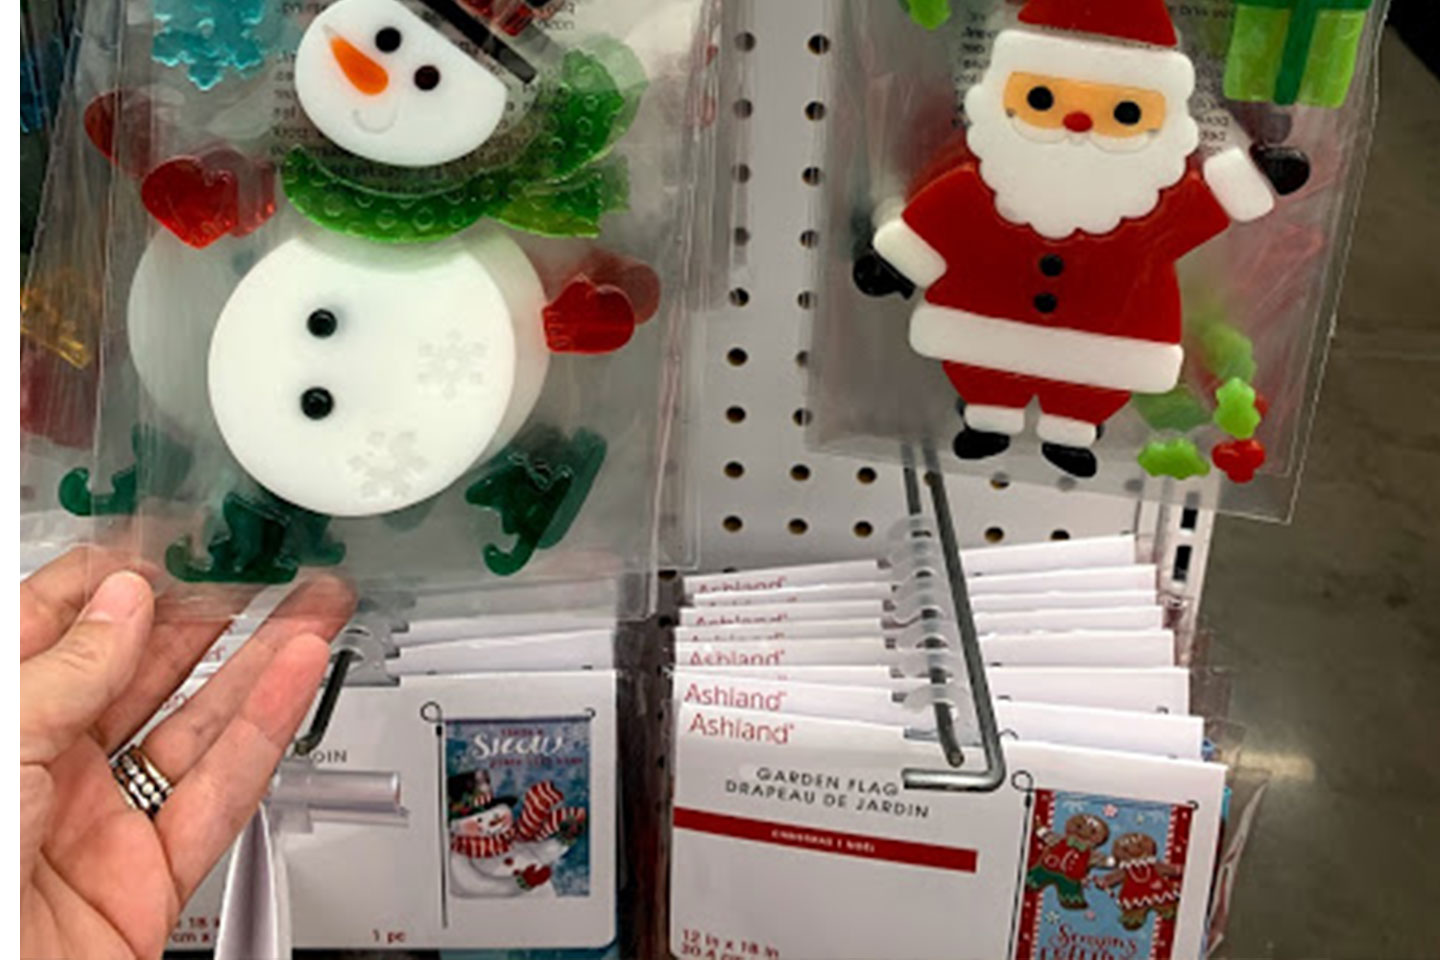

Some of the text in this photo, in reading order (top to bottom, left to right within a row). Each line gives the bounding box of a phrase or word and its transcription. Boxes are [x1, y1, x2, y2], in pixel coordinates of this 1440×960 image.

[684, 683, 786, 712] Ashland
[689, 713, 794, 745] Ashland
[756, 767, 900, 797] GARDEN FLAG
[725, 779, 930, 819] DRAPEAU DE JARDIN
